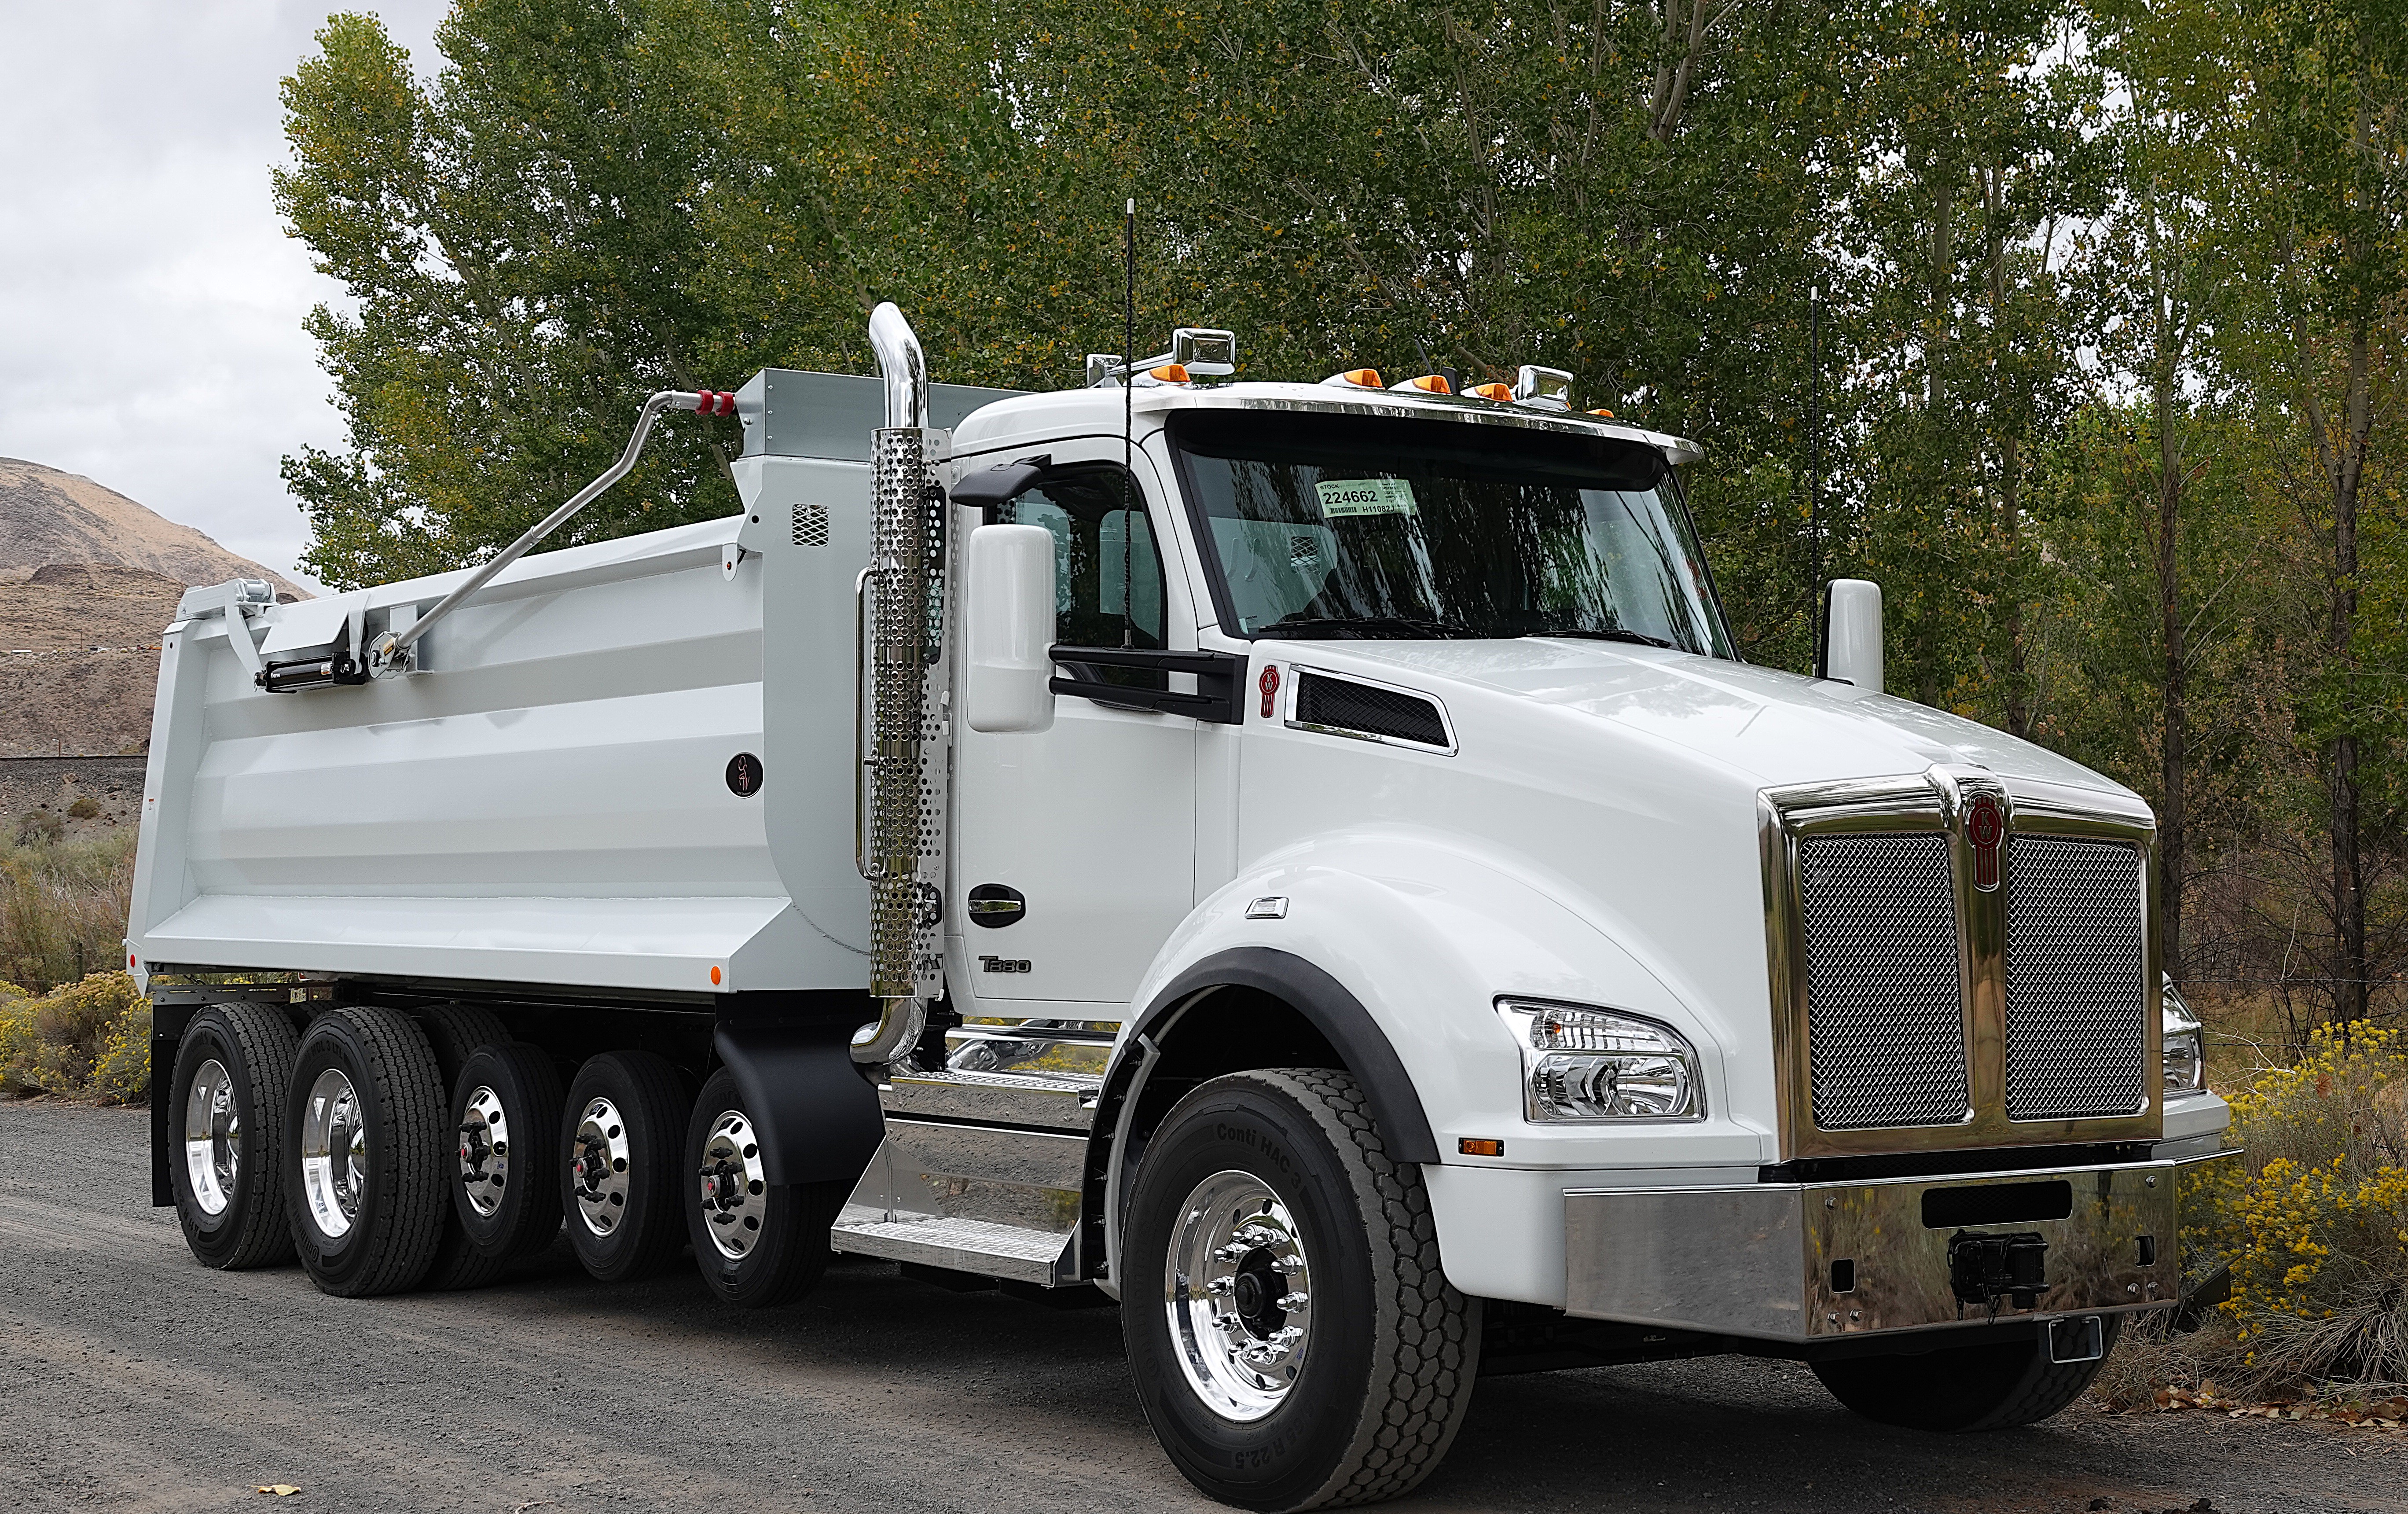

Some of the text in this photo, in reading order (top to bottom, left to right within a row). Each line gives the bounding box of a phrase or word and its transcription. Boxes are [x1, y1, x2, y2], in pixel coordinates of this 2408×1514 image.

[1323, 491, 1378, 504] 224662
[1362, 505, 1395, 513] H11082J
[978, 955, 1031, 972] T880
[1217, 1123, 1302, 1190] Conti HAC 3
[1235, 1446, 1271, 1469] 22.5
